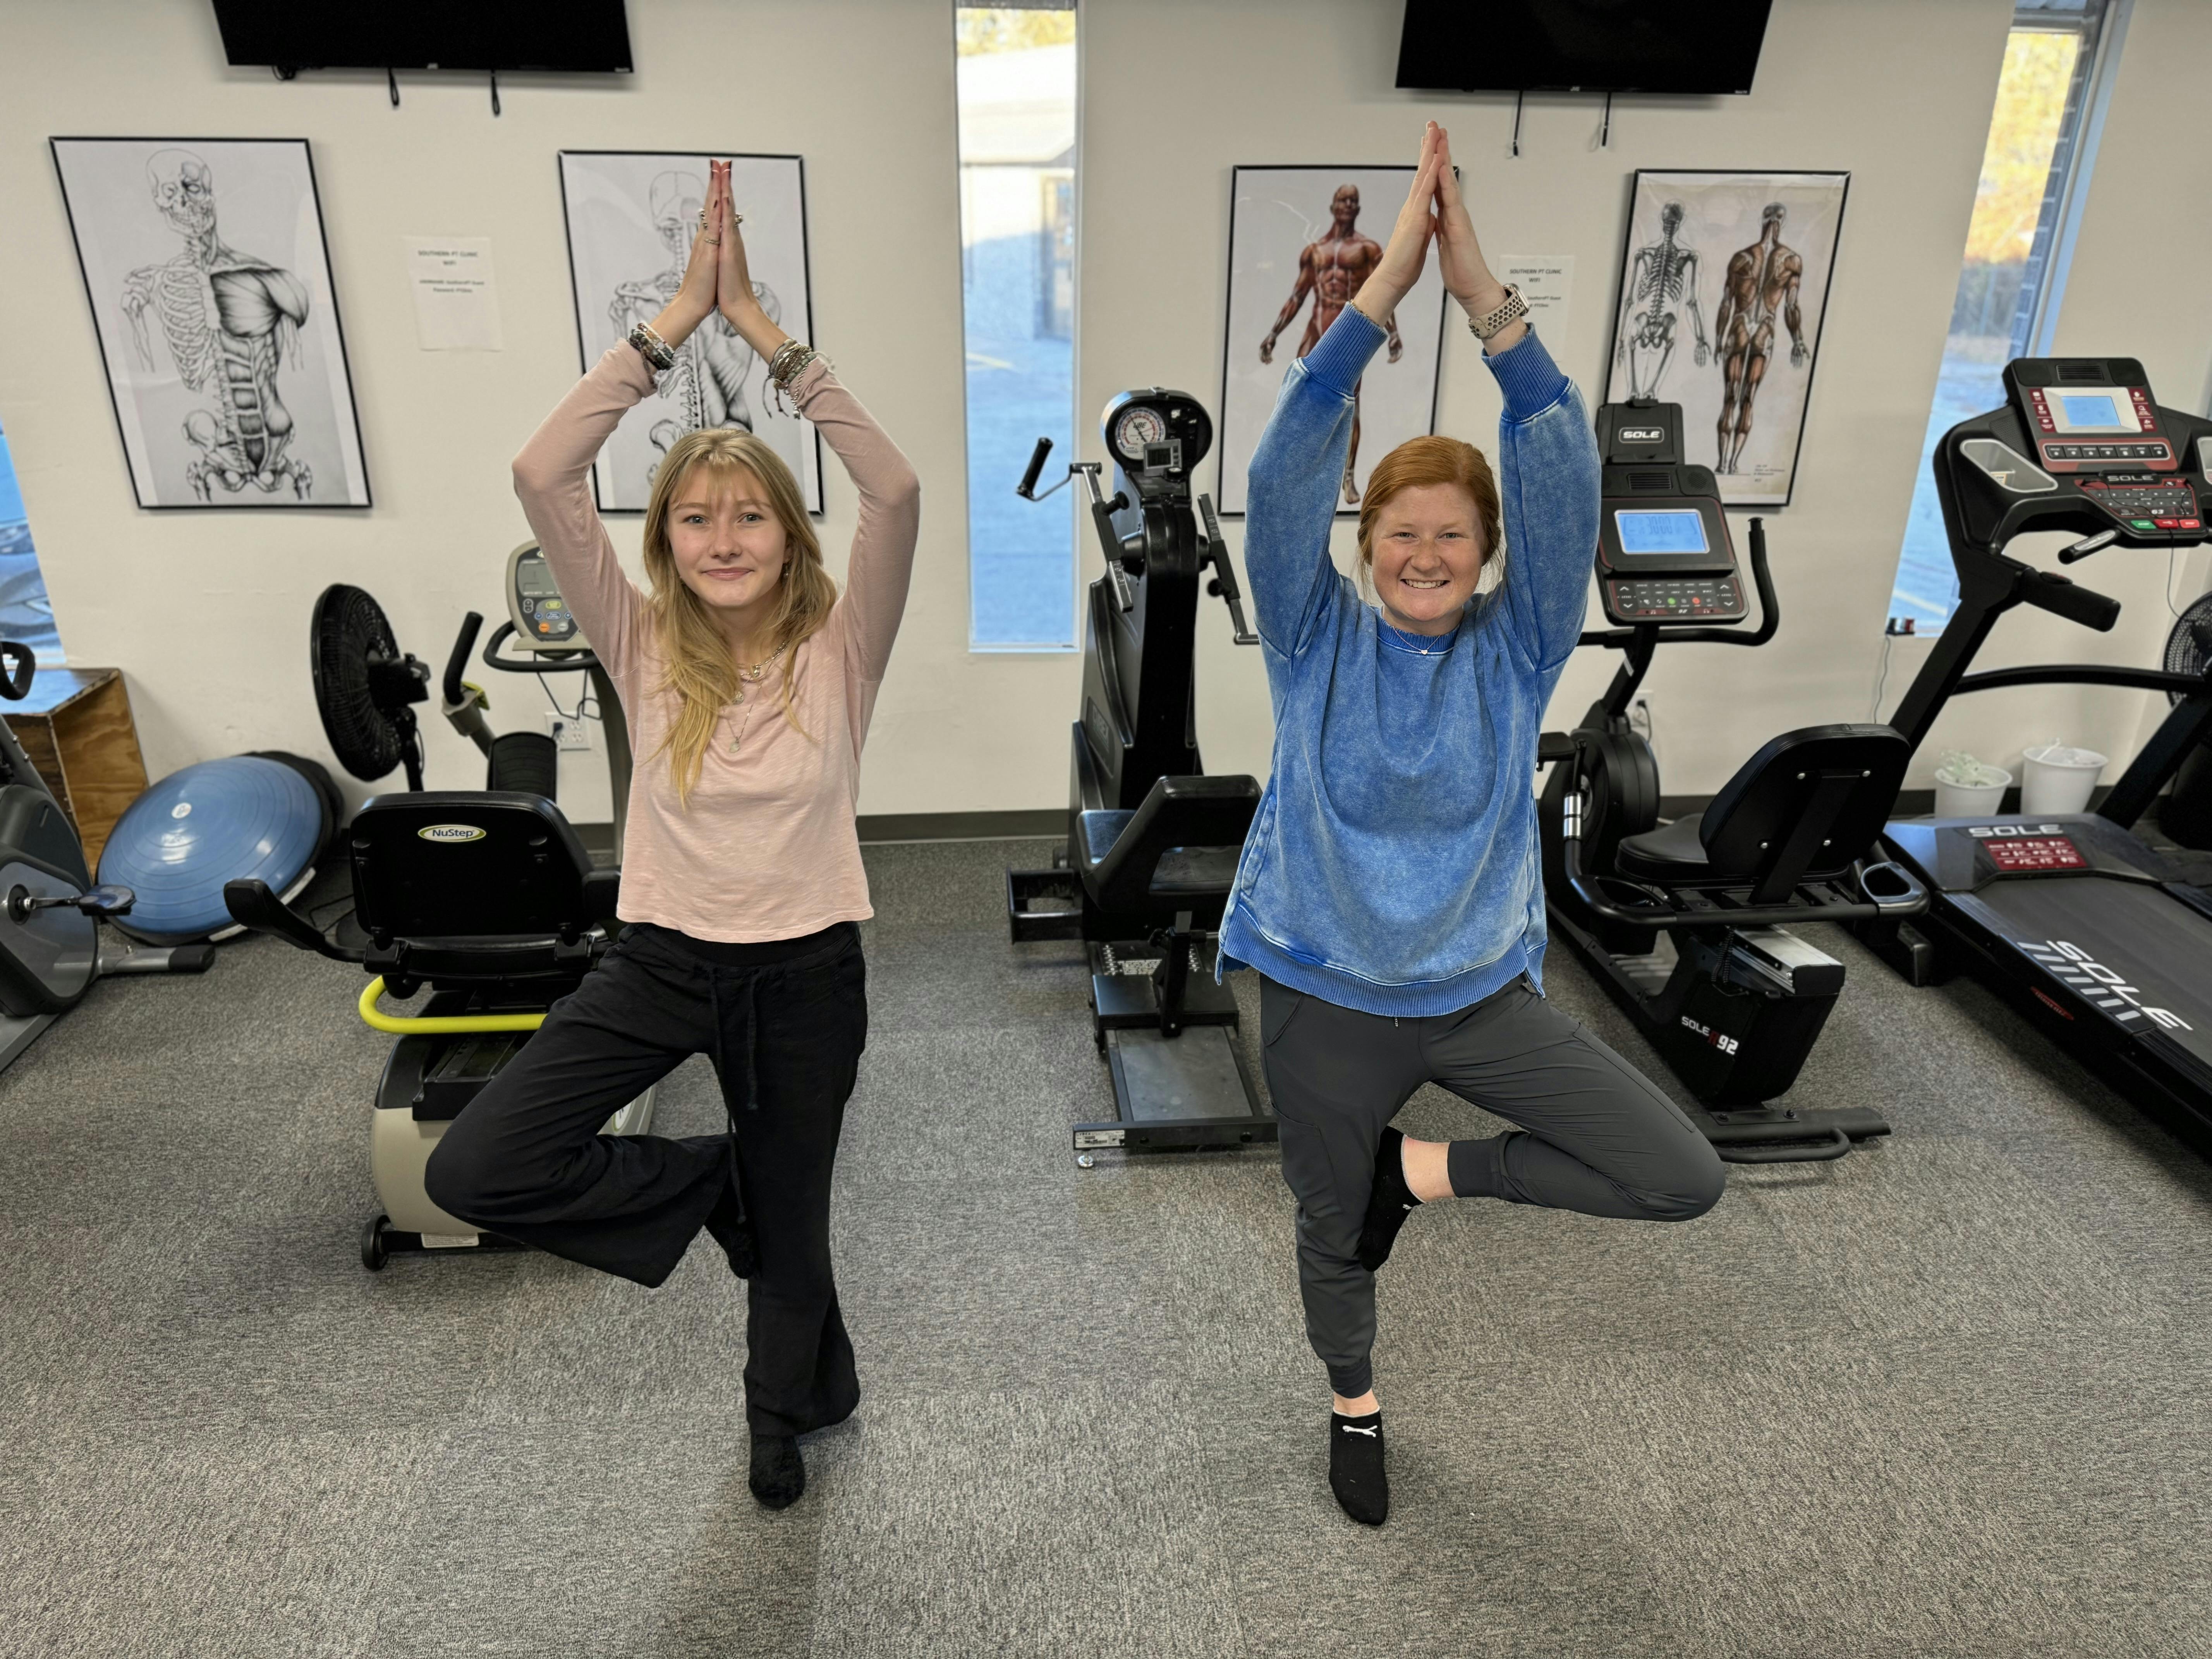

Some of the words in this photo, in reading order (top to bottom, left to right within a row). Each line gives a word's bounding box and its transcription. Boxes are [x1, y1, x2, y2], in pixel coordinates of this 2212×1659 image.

[432, 829, 473, 838] NuStep
[1968, 824, 2063, 838] SOLE
[2046, 940, 2193, 1031] SOLE
[1681, 1016, 1710, 1036] SOLE
